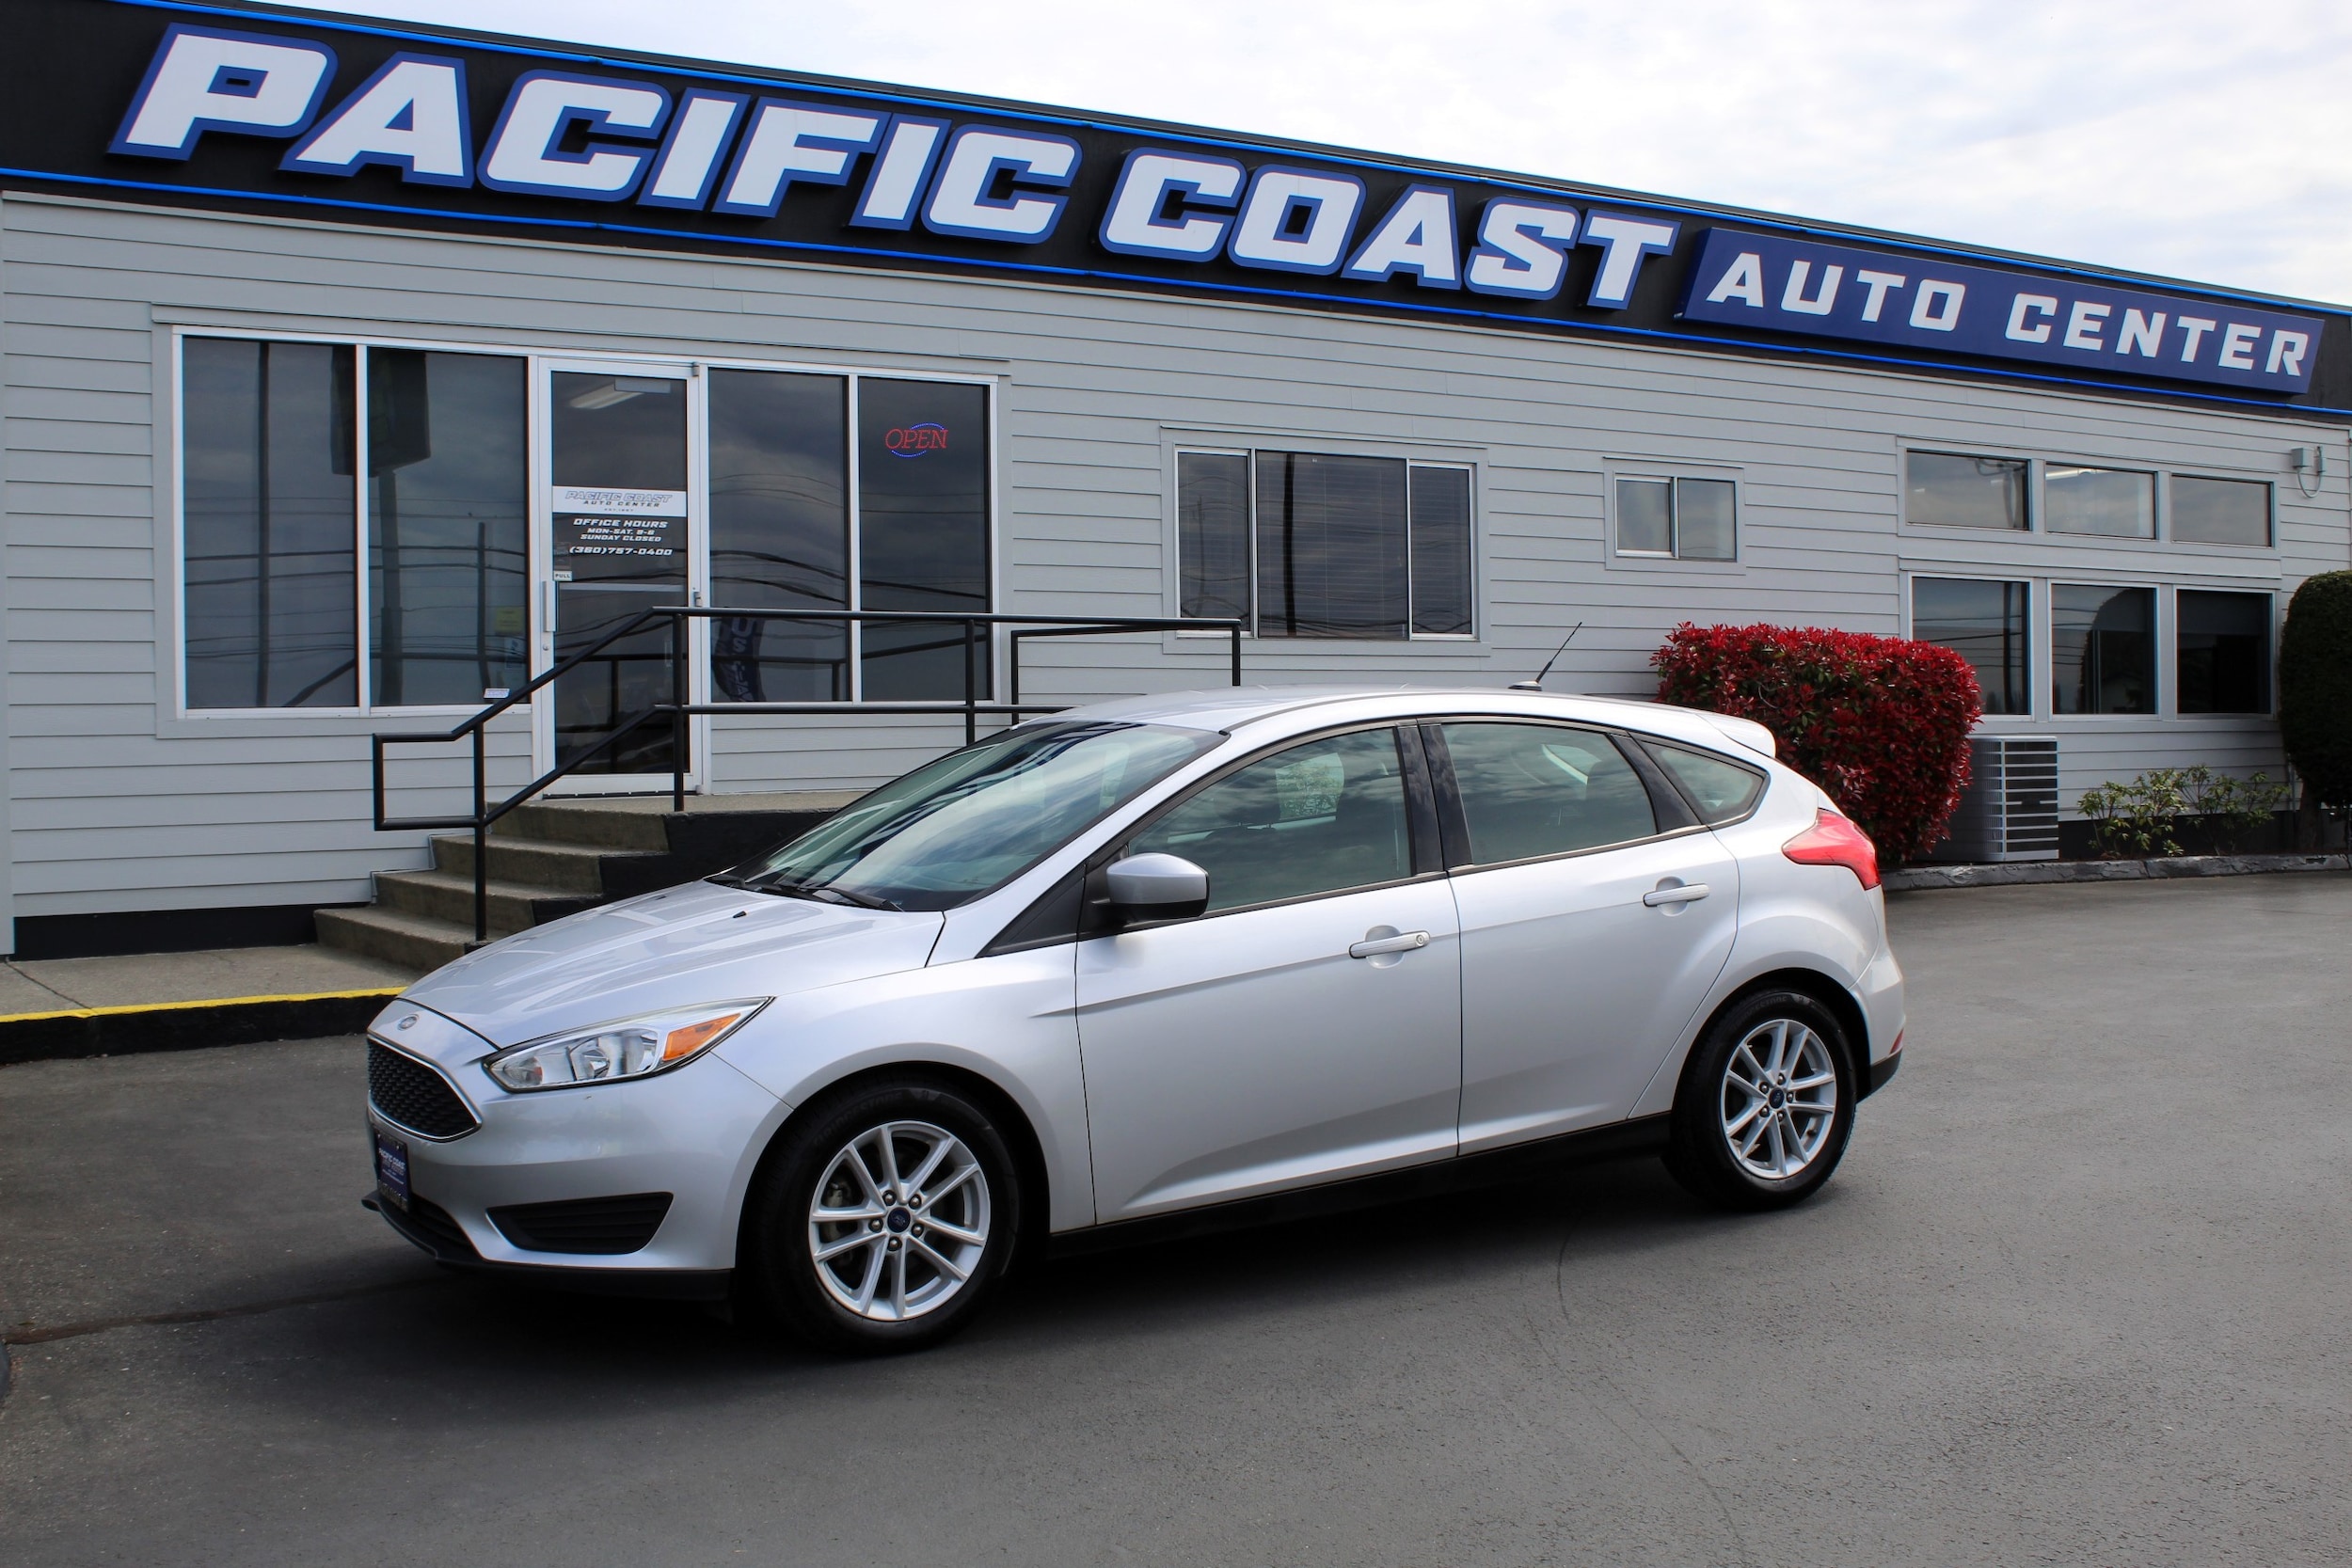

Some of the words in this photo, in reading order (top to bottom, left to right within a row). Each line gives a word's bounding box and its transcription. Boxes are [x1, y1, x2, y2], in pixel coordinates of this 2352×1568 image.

[108, 23, 1083, 245] PACIFIC
[1098, 147, 1682, 309] COAST
[1706, 252, 1966, 332] AUTO
[2004, 293, 2309, 377] CENTER
[884, 428, 948, 450] OPEN
[565, 491, 621, 501] PACIFIC
[623, 493, 672, 503] COAST
[573, 518, 621, 527] OFFICE
[569, 546, 673, 556] (360)757-0400
